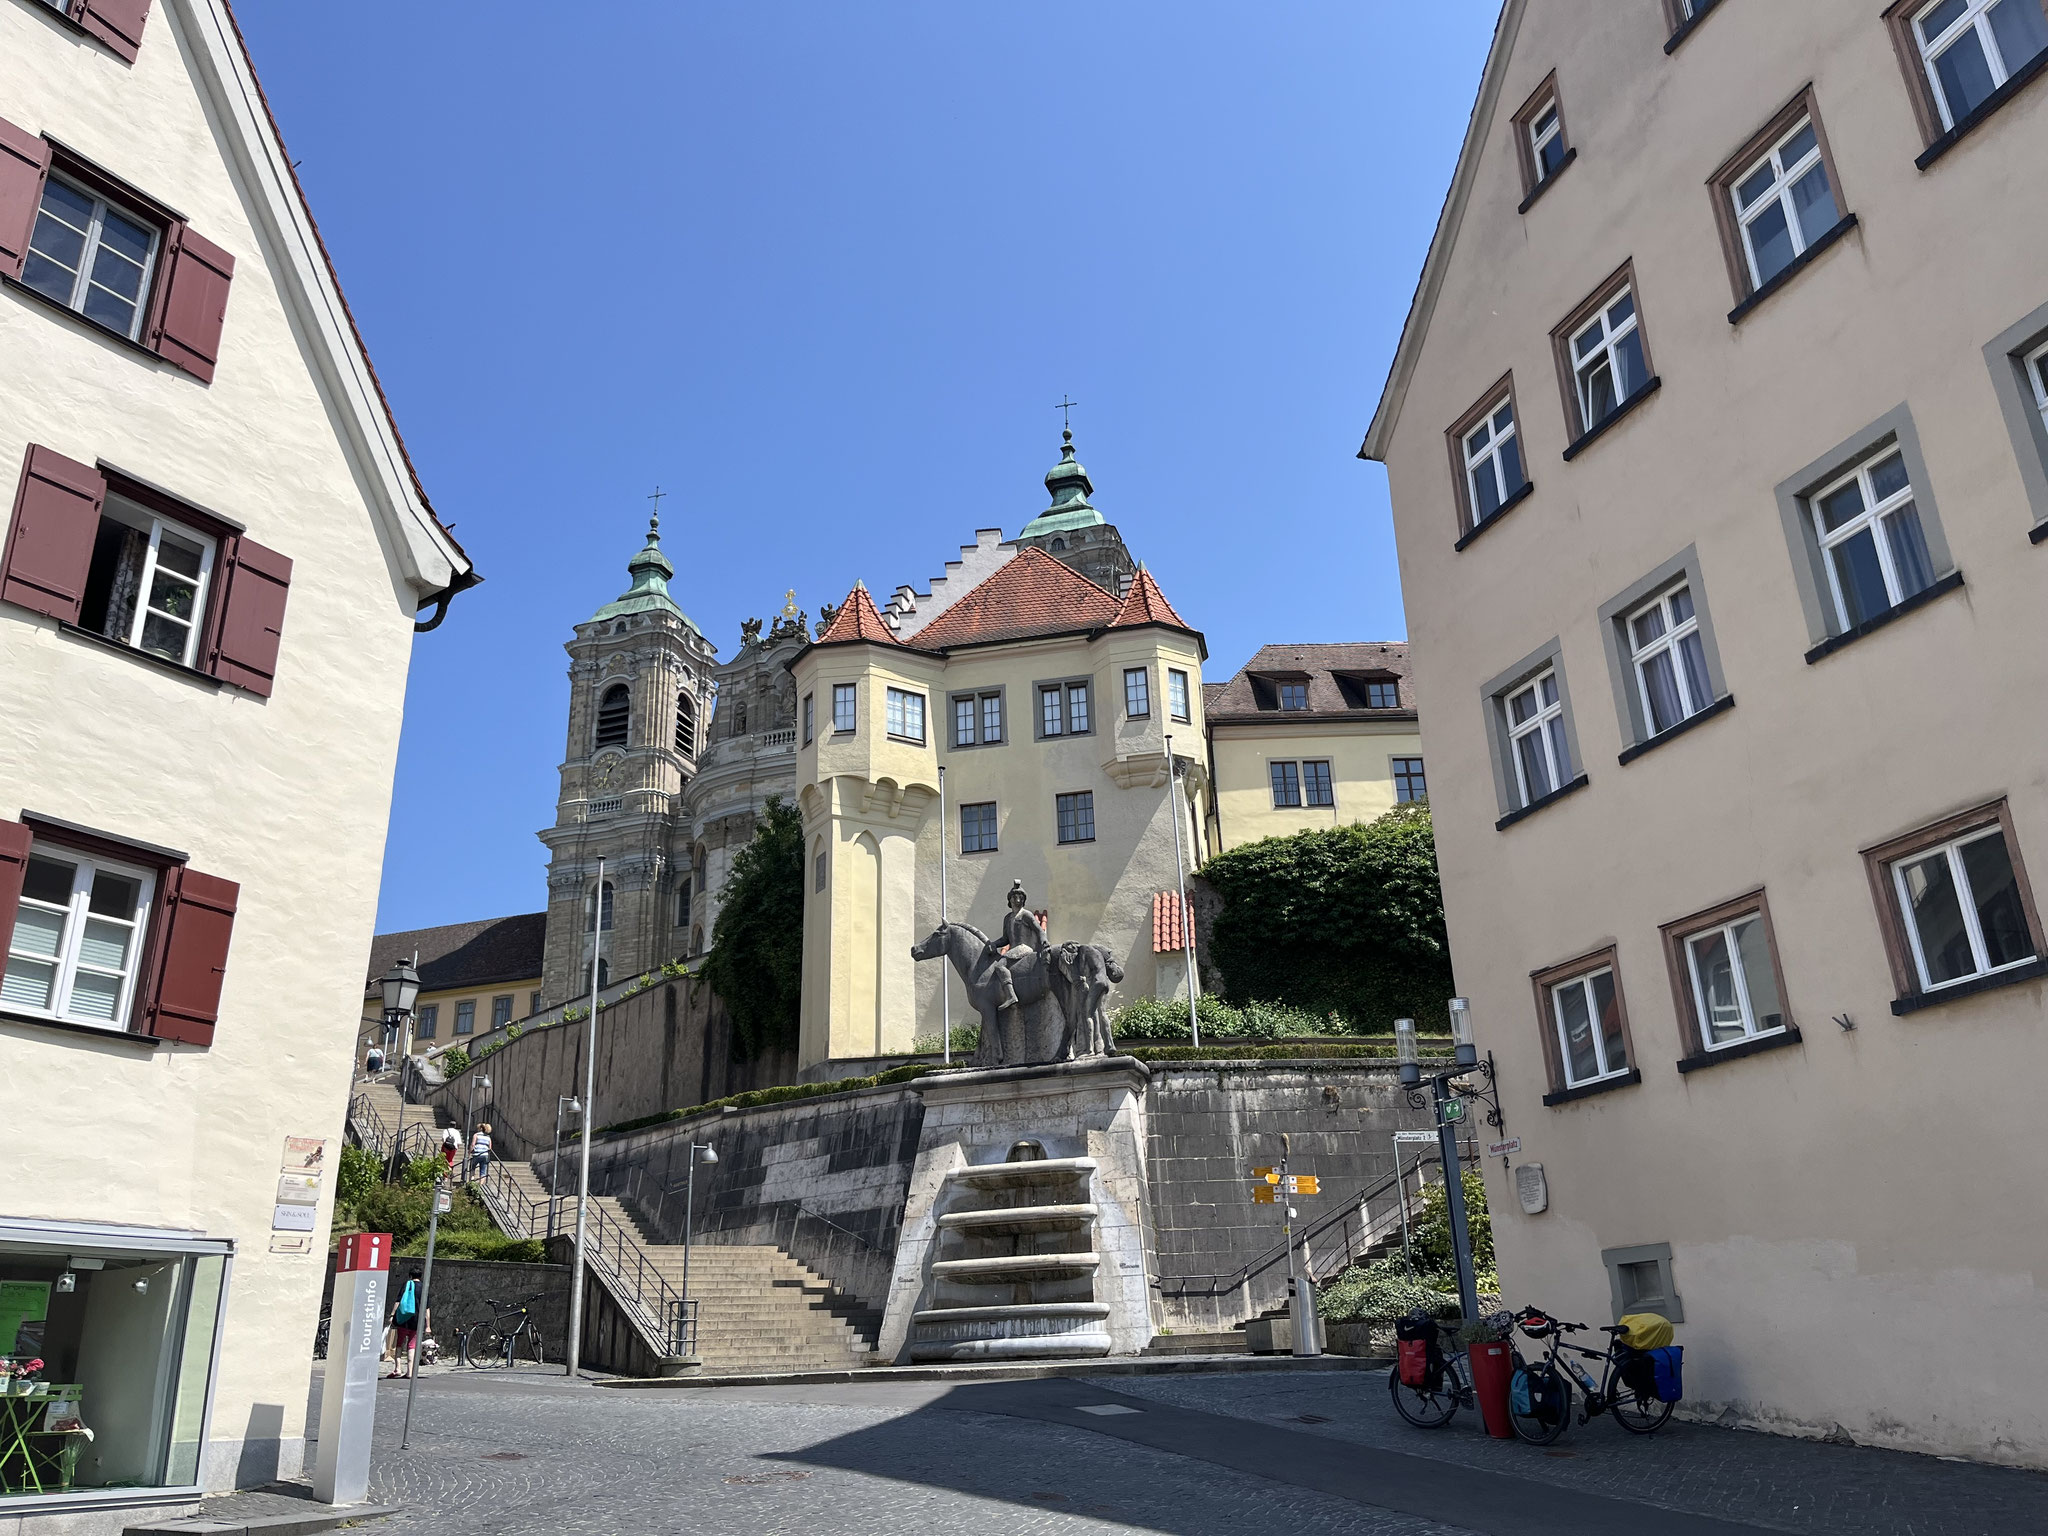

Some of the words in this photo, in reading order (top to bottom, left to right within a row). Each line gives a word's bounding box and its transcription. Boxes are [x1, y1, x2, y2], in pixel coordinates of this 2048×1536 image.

[1490, 1140, 1518, 1153] Münsterplatz
[1503, 1156, 1510, 1169] 2
[360, 1279, 377, 1353] Touristinfo
